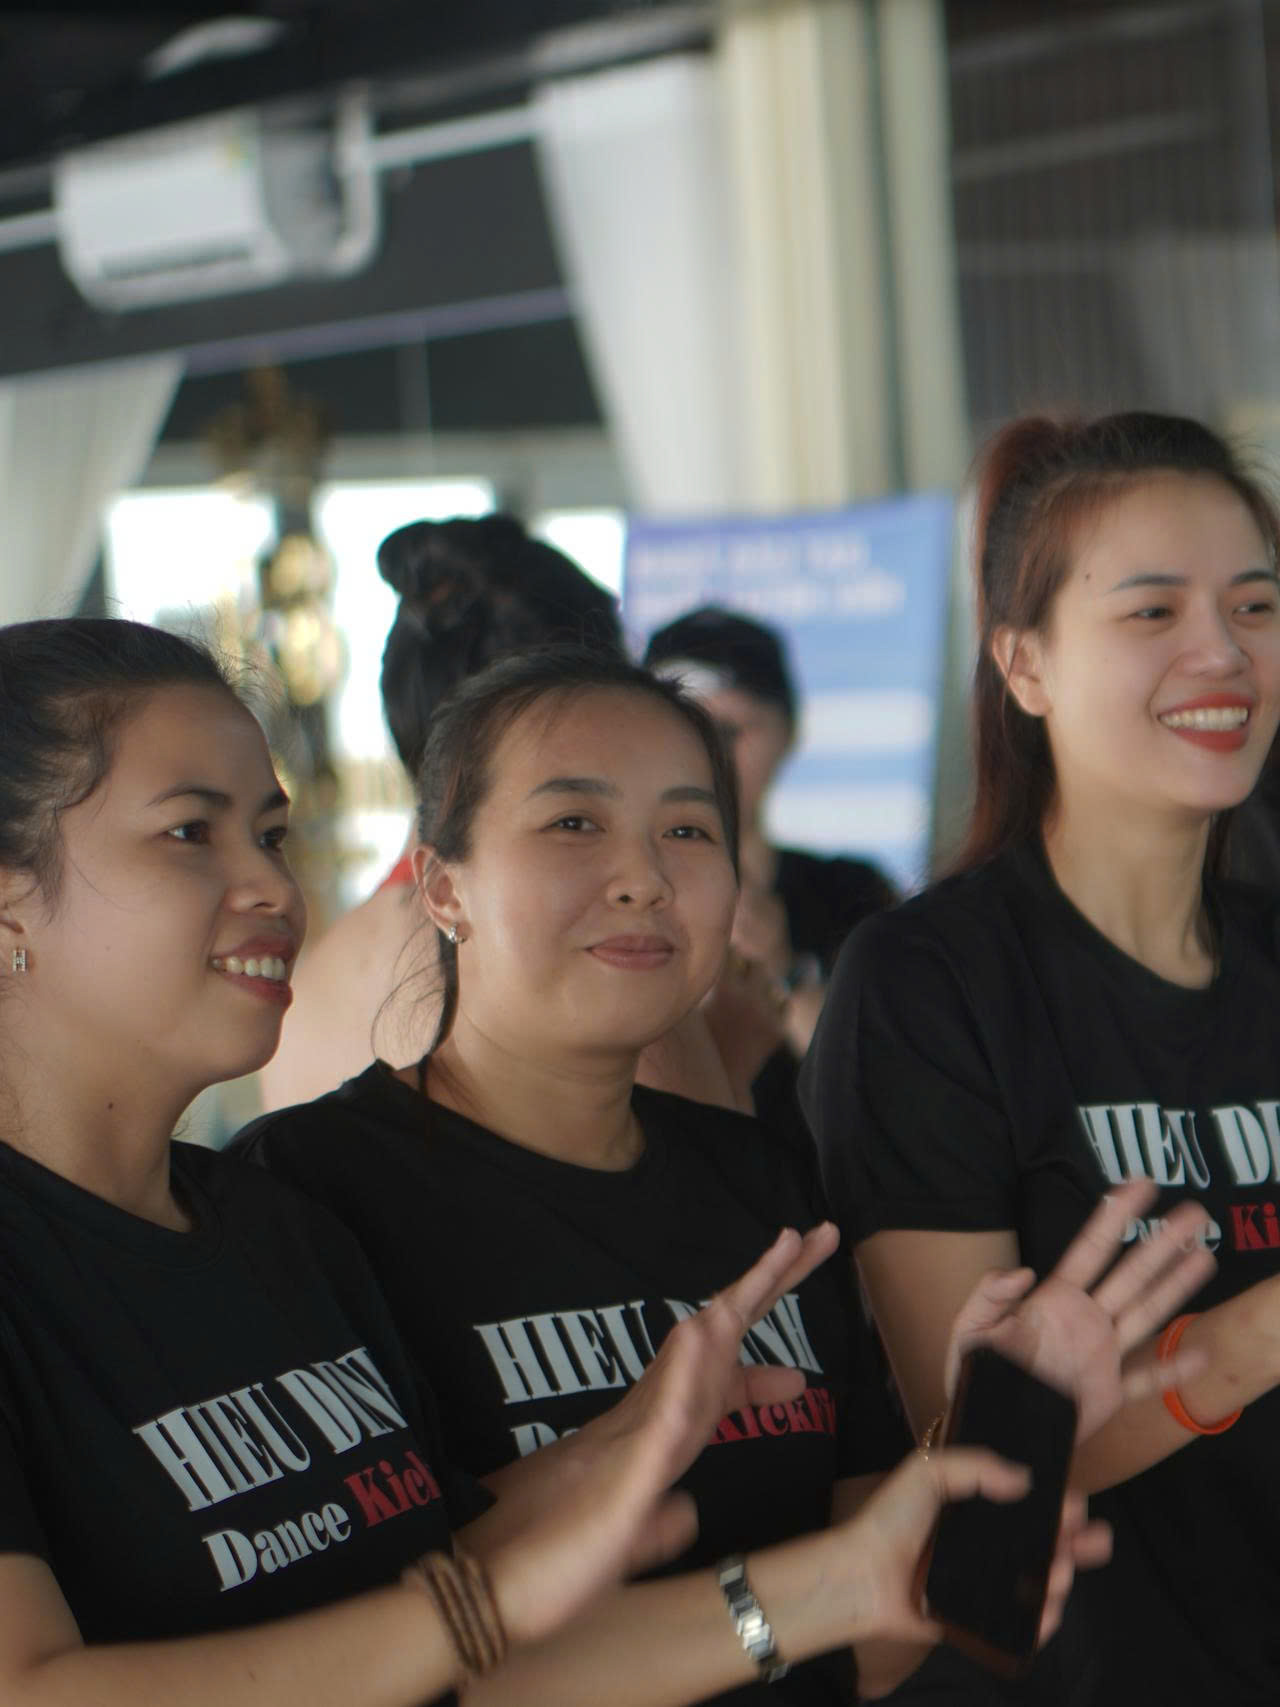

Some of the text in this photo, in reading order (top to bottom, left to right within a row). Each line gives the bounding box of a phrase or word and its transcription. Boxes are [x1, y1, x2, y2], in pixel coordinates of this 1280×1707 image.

[1078, 1103, 1211, 1189] HIEU
[472, 1300, 657, 1405] HIEU
[131, 1382, 312, 1512] HIEU
[201, 1502, 352, 1593] Dance
